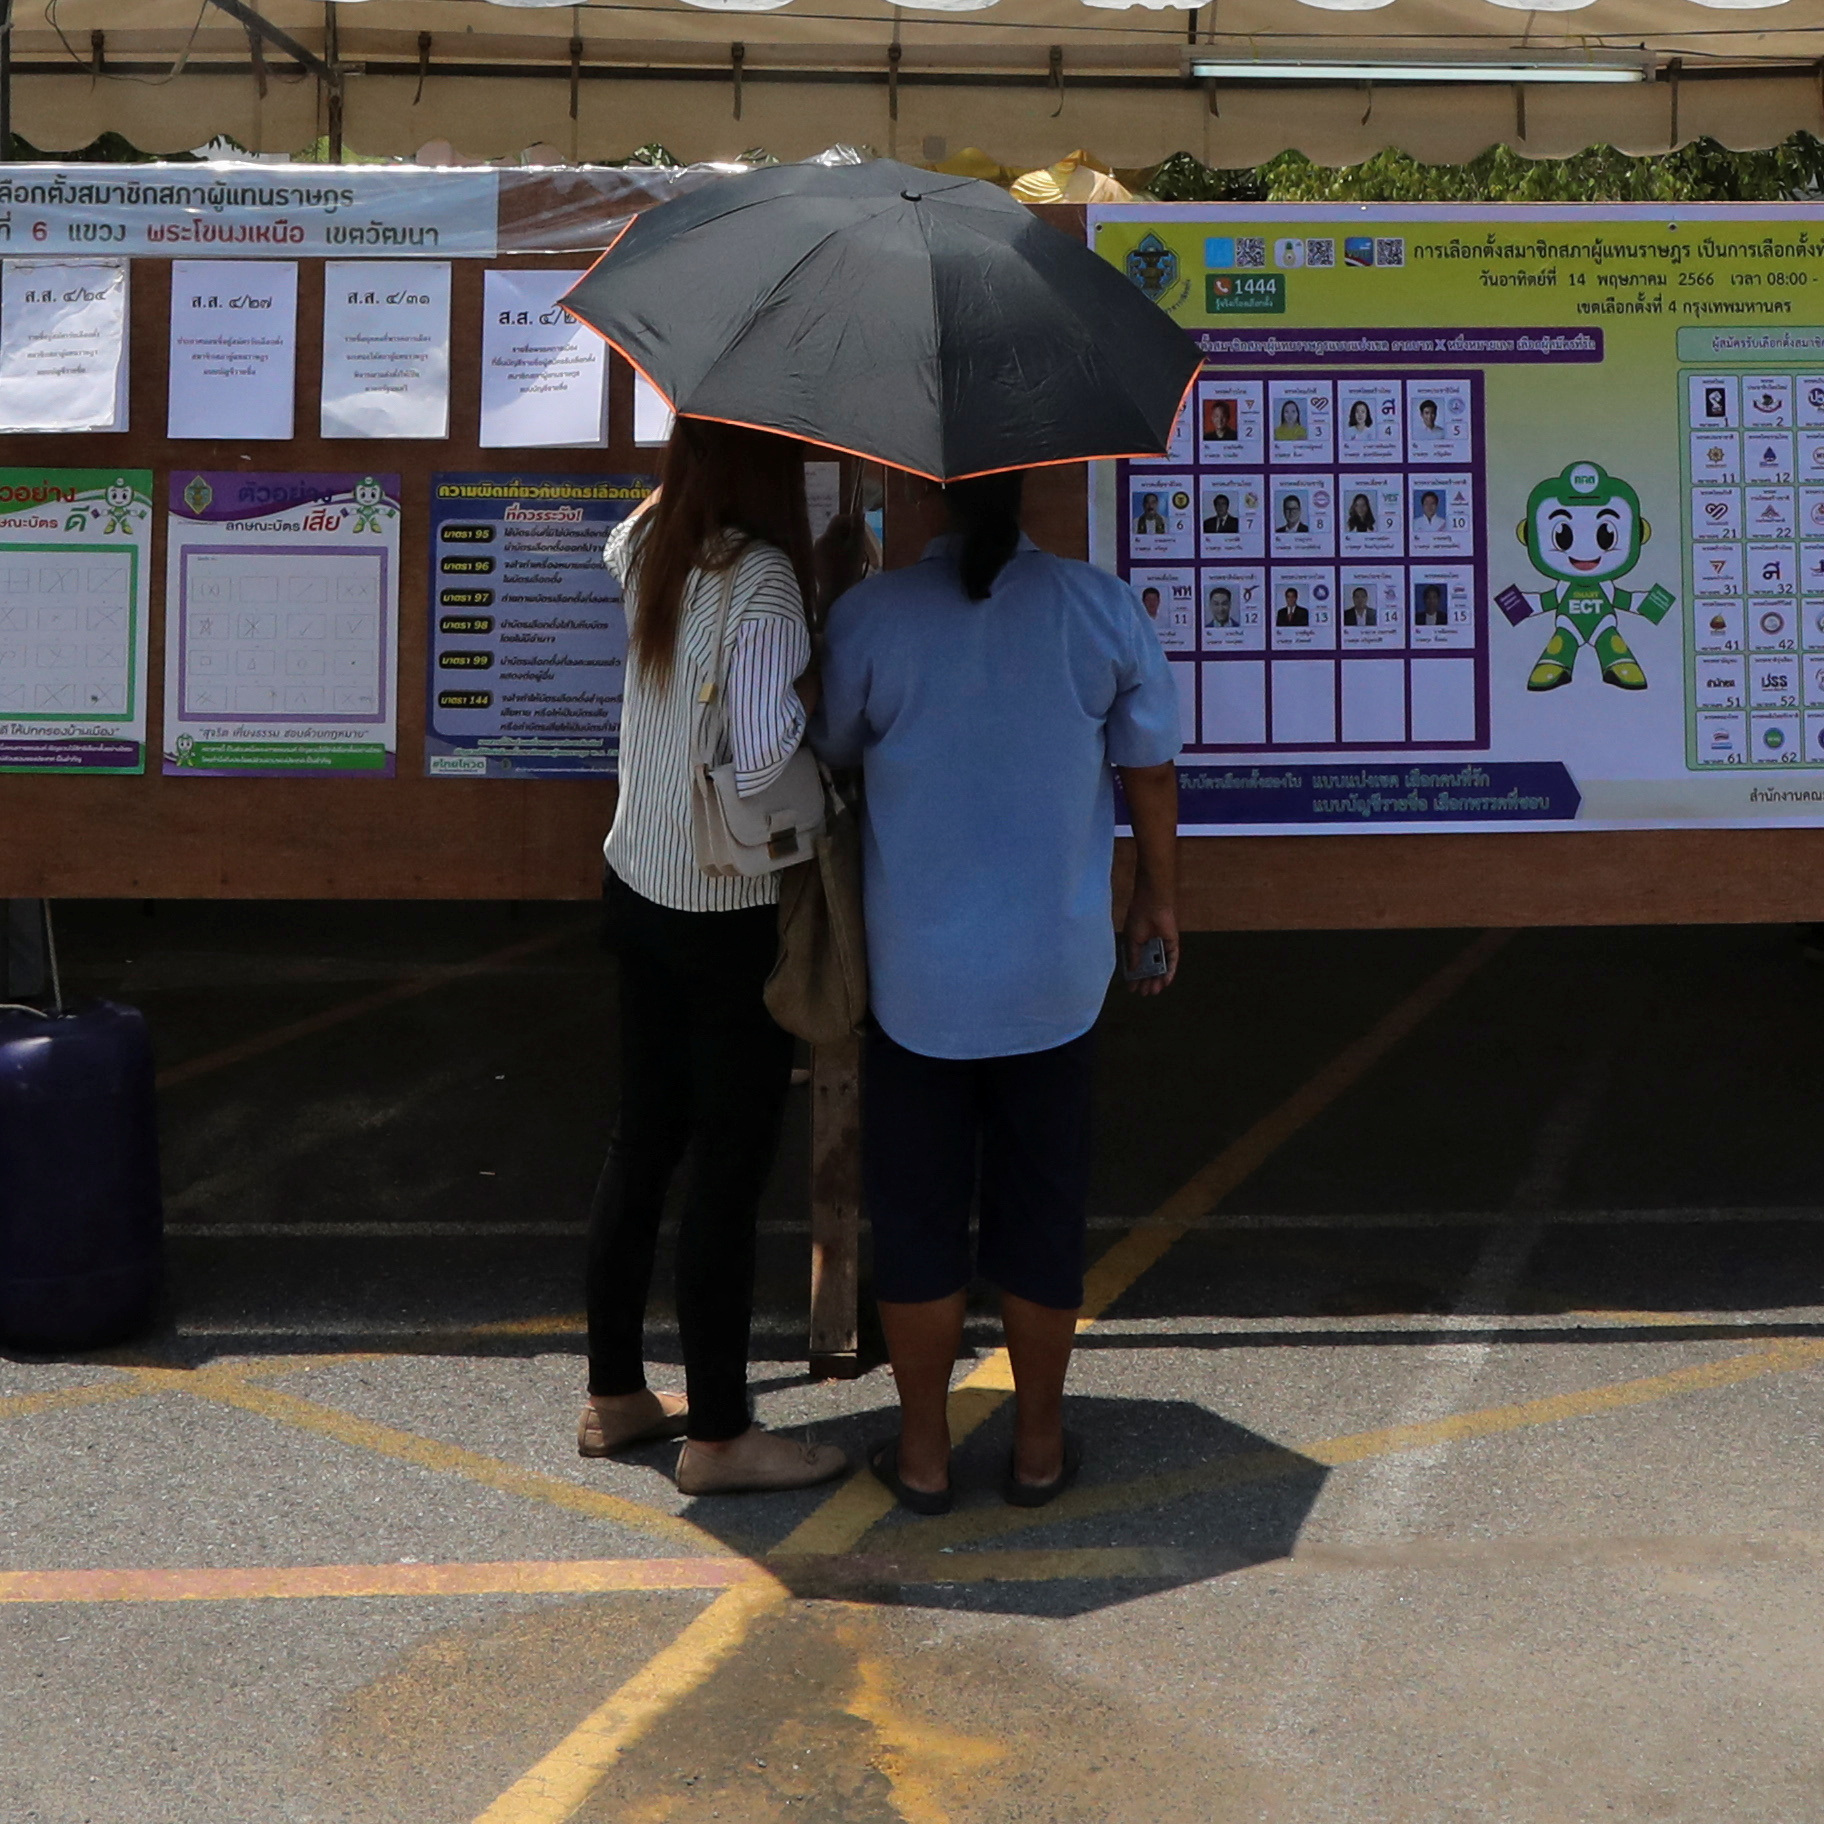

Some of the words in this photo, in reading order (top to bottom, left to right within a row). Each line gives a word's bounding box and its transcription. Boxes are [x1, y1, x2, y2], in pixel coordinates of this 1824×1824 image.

[32, 222, 48, 241] 6
[68, 222, 127, 242] แขวง
[147, 217, 305, 245] พระโขนงเหนือ
[325, 218, 439, 246] เขตวัฒนา
[1414, 233, 1691, 264] การเลือกตั้งสมาชิกสภาผู้แทนราษฎร
[1480, 266, 1557, 287] วันอาทิตย์ที่
[1569, 273, 1586, 286] 14
[1597, 272, 1668, 288] พฤษภาคม
[1678, 273, 1715, 286] 2566
[1731, 274, 1762, 286] เวลา
[1767, 273, 1808, 286] 08:00
[1235, 278, 1277, 294] 1444
[26, 289, 56, 302] ส.ส.
[348, 292, 379, 304] ส.ส.
[192, 296, 222, 308] ส.ส.
[1576, 292, 1663, 315] เขตเลือกตั้งที่
[1668, 300, 1677, 313] 4
[1683, 301, 1792, 318] กรุงเทพมหานคร
[499, 311, 533, 325] ส.ส.
[1724, 418, 1729, 427] 1
[1777, 417, 1783, 426] 2
[1176, 428, 1181, 437] 1
[1246, 428, 1253, 437] 2
[1315, 427, 1322, 436] 3
[1385, 427, 1391, 435] 4
[1454, 427, 1460, 436] 5
[1722, 474, 1735, 482] 11
[1776, 473, 1790, 482] 12
[64, 506, 90, 531] ดี
[303, 509, 341, 531] เสีย
[1177, 520, 1183, 530] 6
[1247, 520, 1253, 528] 7
[1317, 519, 1323, 529] 8
[1386, 519, 1393, 528] 9
[1452, 519, 1465, 528] 10
[475, 529, 489, 538] 95
[1723, 529, 1736, 538] 21
[1777, 528, 1791, 538] 22
[475, 561, 489, 571] 96
[1724, 585, 1737, 594] 31
[1777, 584, 1792, 593] 32
[474, 593, 489, 602] 97
[1569, 599, 1604, 614] ECT
[1175, 614, 1187, 624] 11
[1245, 614, 1258, 623] 12
[1316, 613, 1328, 623] 13
[1385, 612, 1397, 622] 14
[1454, 611, 1466, 621] 15
[474, 620, 488, 629] 98
[1725, 641, 1738, 650] 41
[1779, 640, 1794, 649] 42
[474, 656, 488, 664] 99
[469, 696, 488, 705] 144
[1727, 698, 1740, 707] 51
[1781, 696, 1795, 706] 52
[1728, 754, 1741, 763] 61
[1782, 753, 1797, 762] 62
